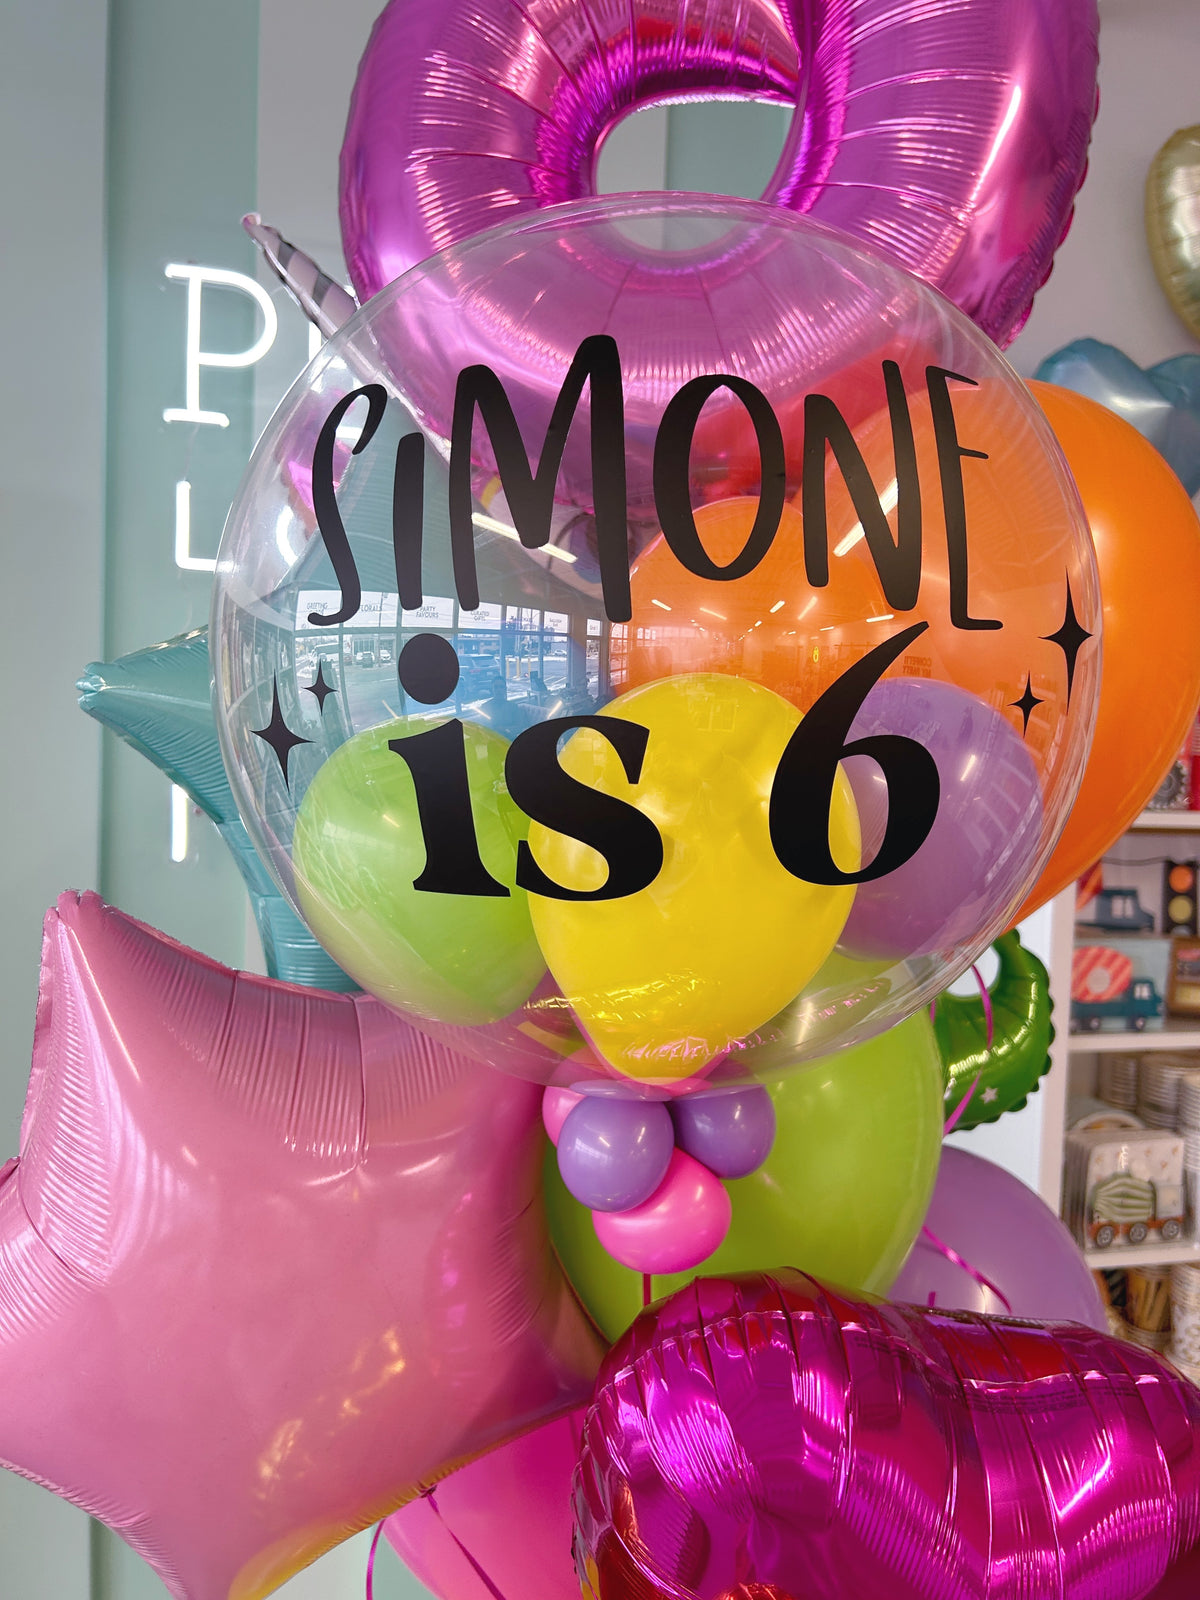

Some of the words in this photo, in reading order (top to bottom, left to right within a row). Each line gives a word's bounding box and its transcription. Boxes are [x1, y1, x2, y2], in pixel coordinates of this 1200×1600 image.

[308, 335, 1004, 631] SIMONE
[388, 633, 664, 902] is
[769, 622, 940, 887] 6
